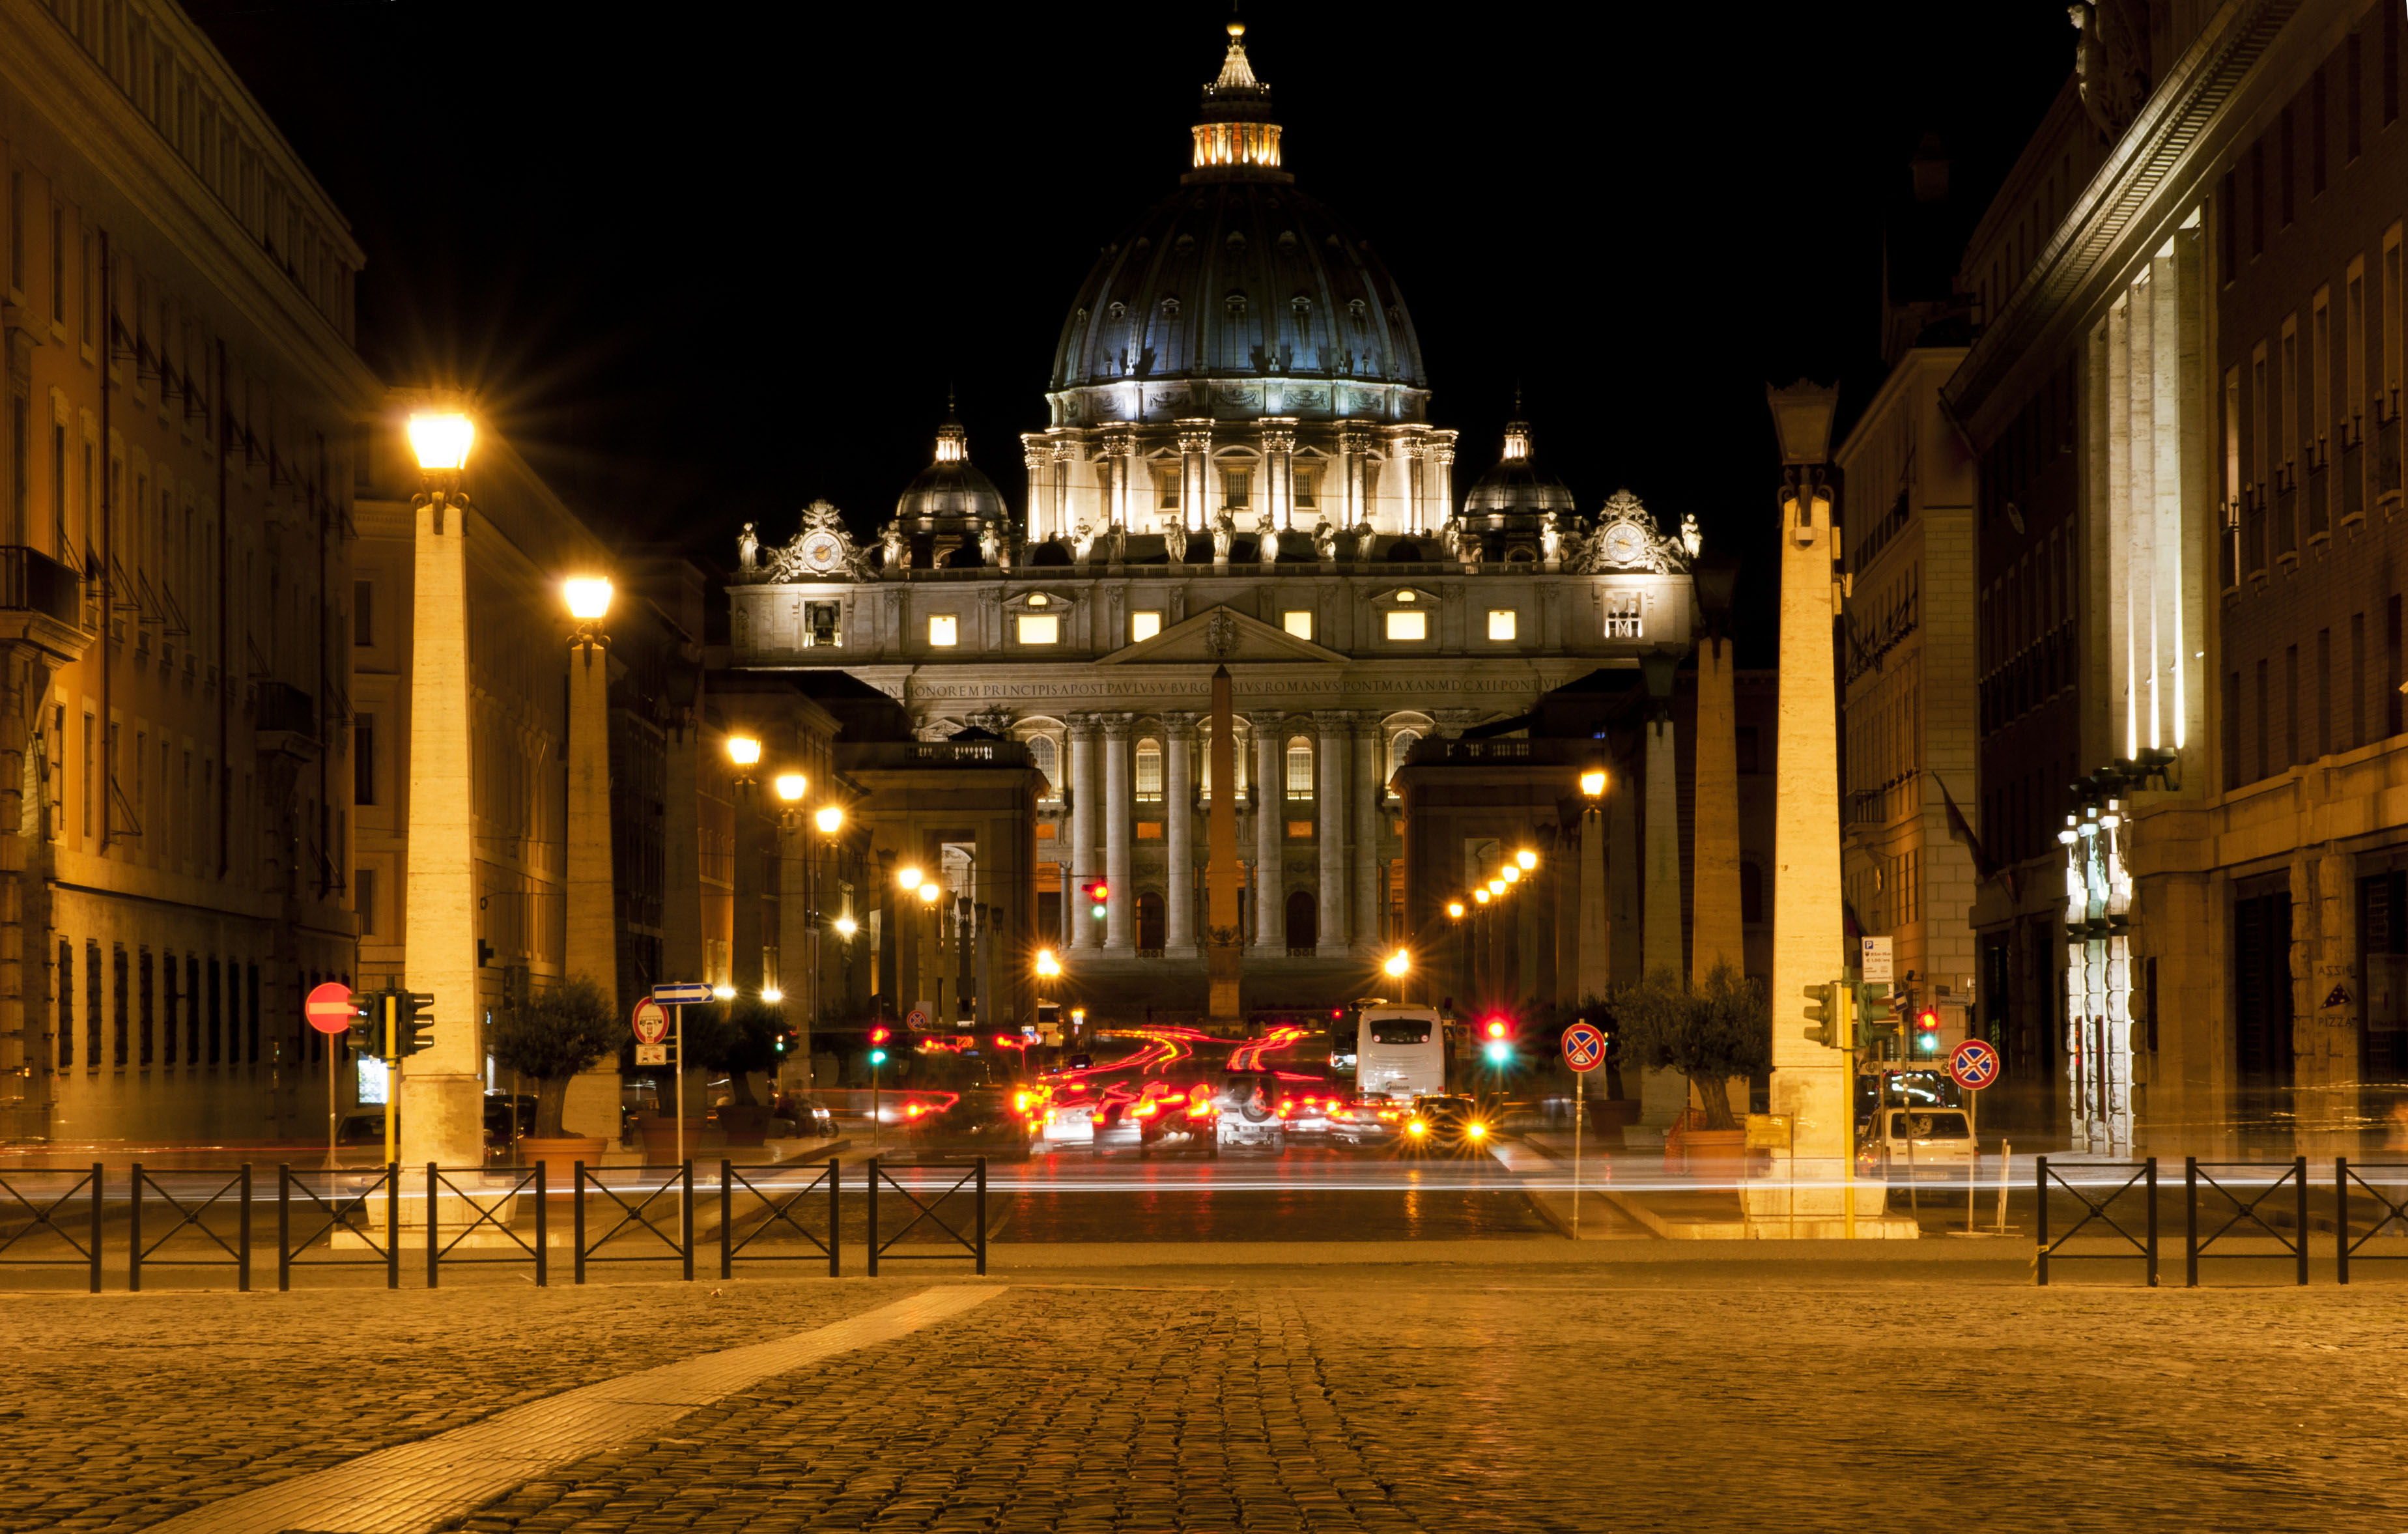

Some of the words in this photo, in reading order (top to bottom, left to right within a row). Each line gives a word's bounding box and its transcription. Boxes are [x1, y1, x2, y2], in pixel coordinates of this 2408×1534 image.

[881, 686, 898, 696] IN
[905, 685, 979, 697] HONOREM
[984, 684, 1057, 696] PRINCIPIS
[1060, 683, 1105, 695] APOST
[1107, 683, 1156, 694] PAVLVS
[1265, 681, 1339, 692] ROMANVS
[1343, 680, 1381, 692] PONT
[1381, 680, 1413, 691] MAX
[1415, 679, 1436, 691] AN
[1501, 679, 1538, 690] PONT
[2317, 1017, 2352, 1027] PIZZA
